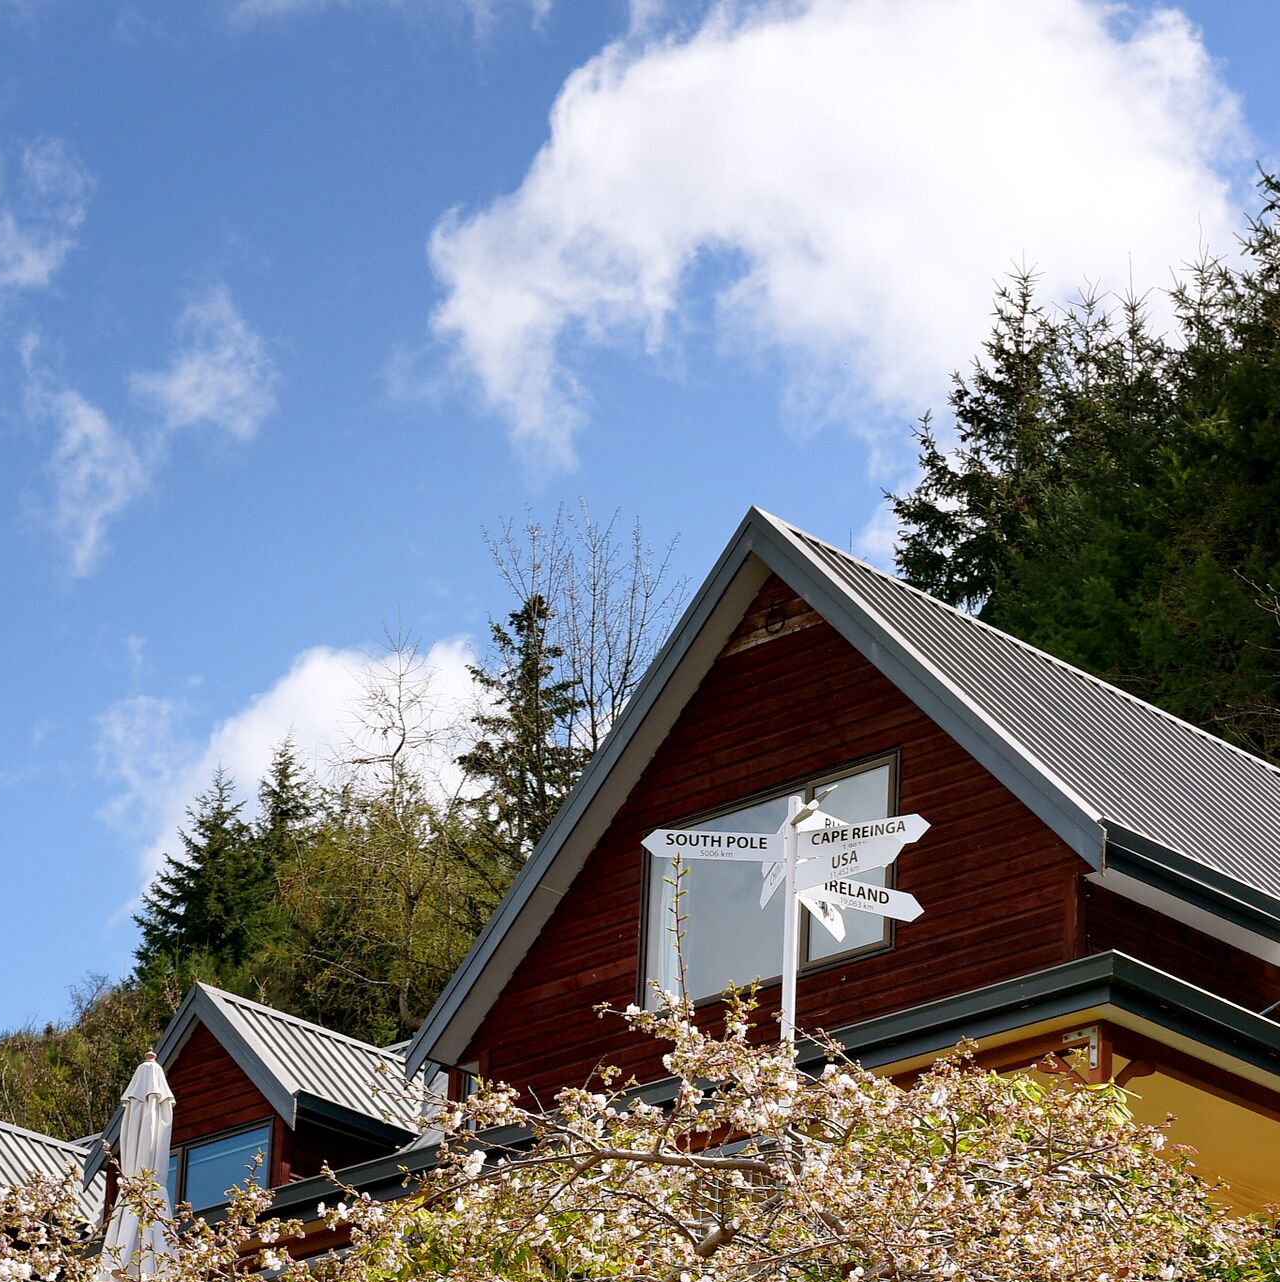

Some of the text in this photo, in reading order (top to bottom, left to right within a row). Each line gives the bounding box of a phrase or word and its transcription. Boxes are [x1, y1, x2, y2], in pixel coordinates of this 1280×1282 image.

[666, 833, 768, 850] SOUTH POLE
[811, 829, 849, 845] CAPE
[852, 820, 906, 840] REINGA
[700, 849, 734, 858] 5006 km
[831, 850, 858, 869] USA
[824, 880, 890, 905] IRELAND
[863, 901, 874, 911] km
